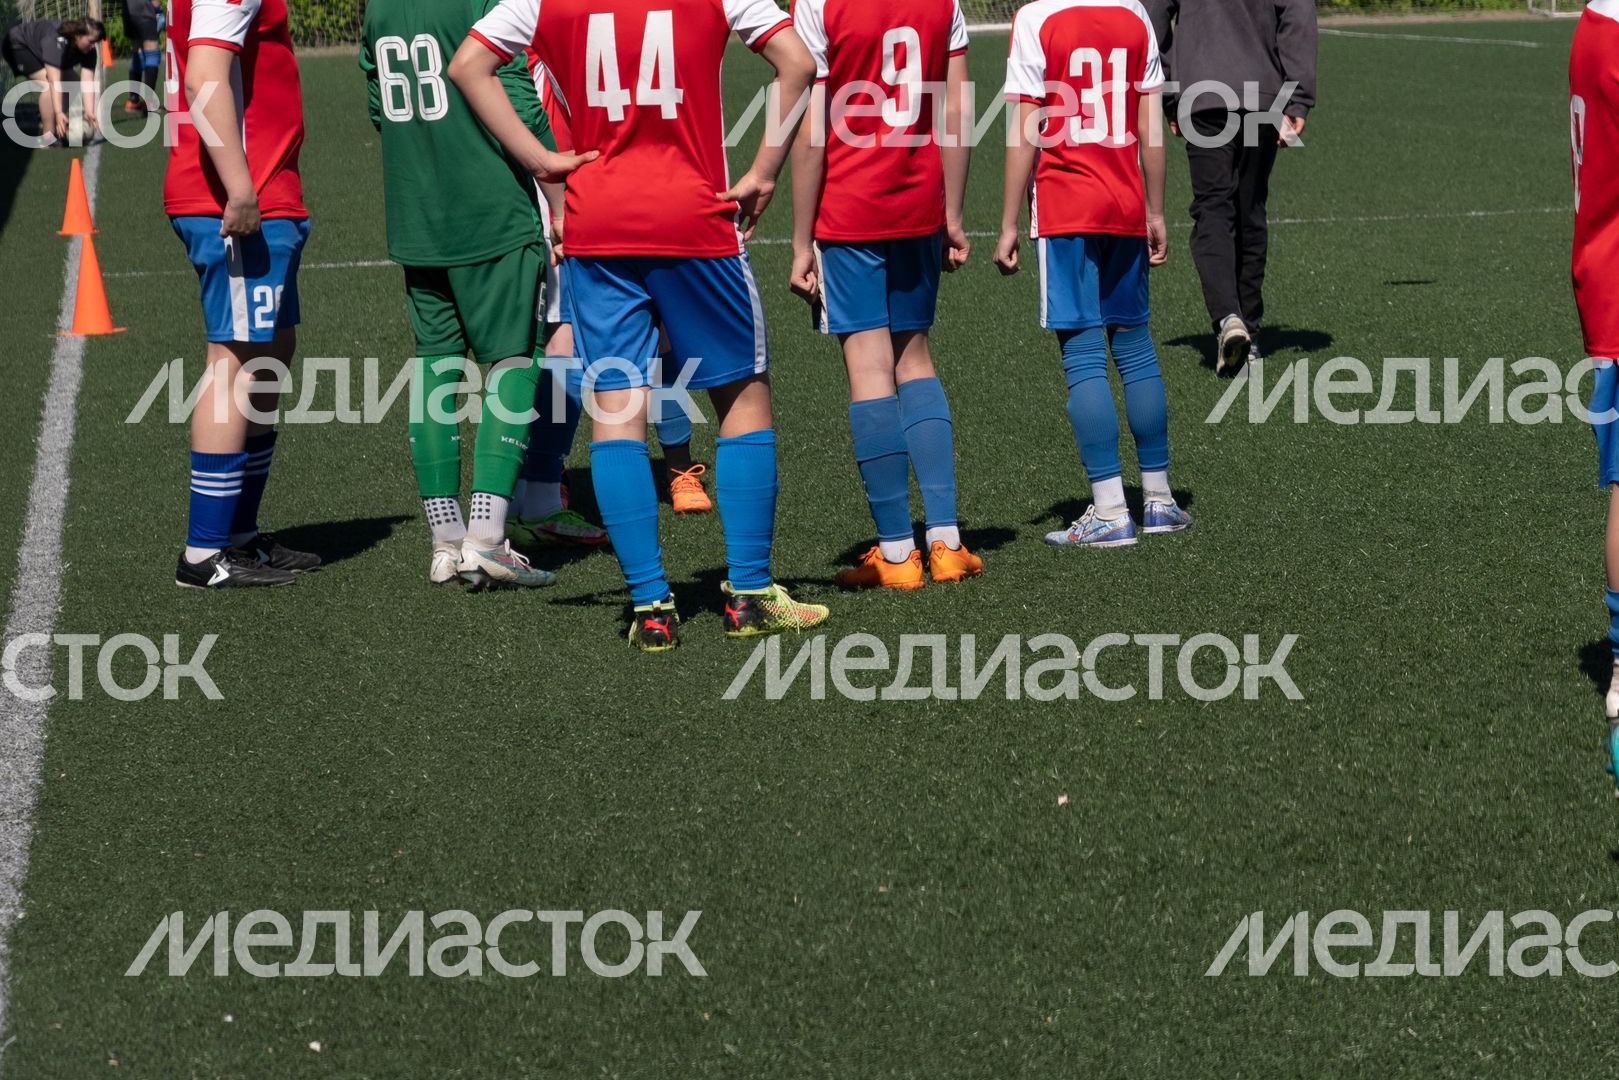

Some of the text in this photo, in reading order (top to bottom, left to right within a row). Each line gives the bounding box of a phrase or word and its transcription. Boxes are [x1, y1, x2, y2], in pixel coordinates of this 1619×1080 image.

[375, 34, 449, 122] 68
[585, 10, 684, 122] 44
[881, 26, 923, 128] 9
[1069, 47, 1128, 145] 31
